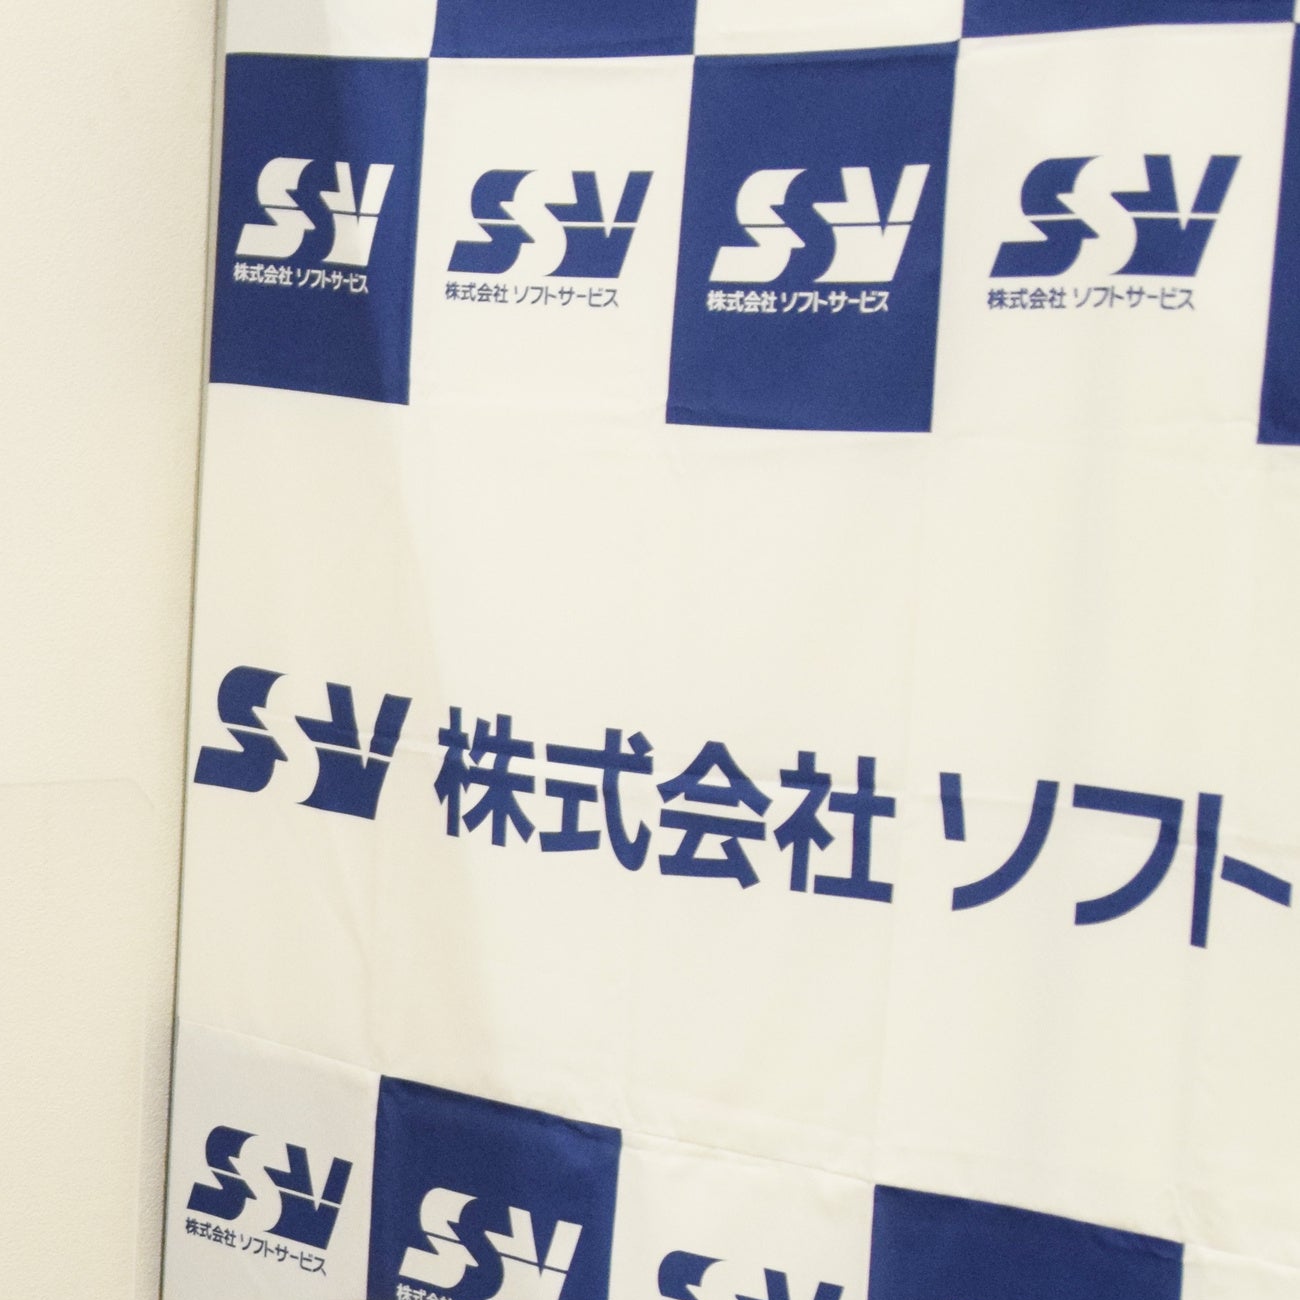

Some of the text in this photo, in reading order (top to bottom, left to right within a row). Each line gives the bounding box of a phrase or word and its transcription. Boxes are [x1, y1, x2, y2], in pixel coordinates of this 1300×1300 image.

[434, 706, 897, 906] 株式会社
[938, 770, 1293, 950] ソフト
